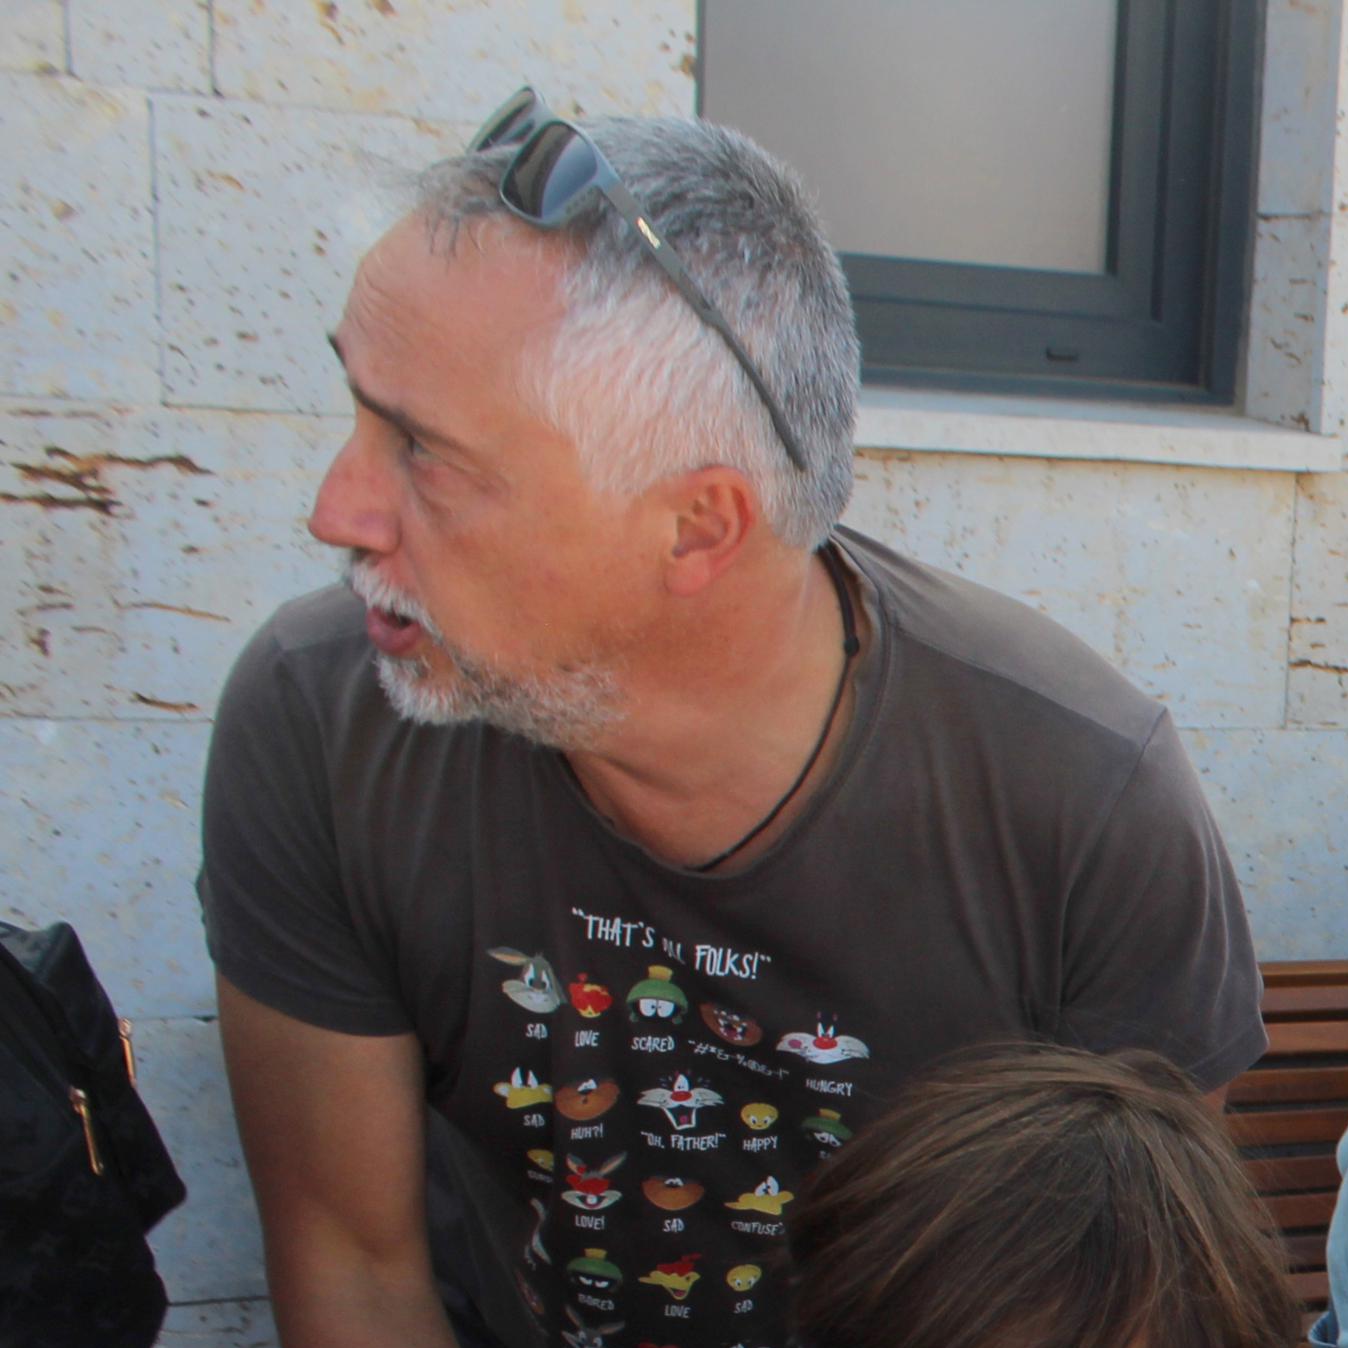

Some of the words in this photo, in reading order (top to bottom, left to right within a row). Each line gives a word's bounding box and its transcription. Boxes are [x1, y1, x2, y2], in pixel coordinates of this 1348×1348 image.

[525, 1023, 548, 1039] SAD
[574, 1030, 599, 1047] LOVE
[631, 1035, 675, 1052] SCARED
[805, 1077, 853, 1097] HUNGRY
[523, 1114, 545, 1128] SAD
[742, 1136, 779, 1153] HAPPY
[663, 1218, 685, 1233] SAD
[664, 1304, 690, 1319] LOVE
[734, 1300, 754, 1314] SAD
